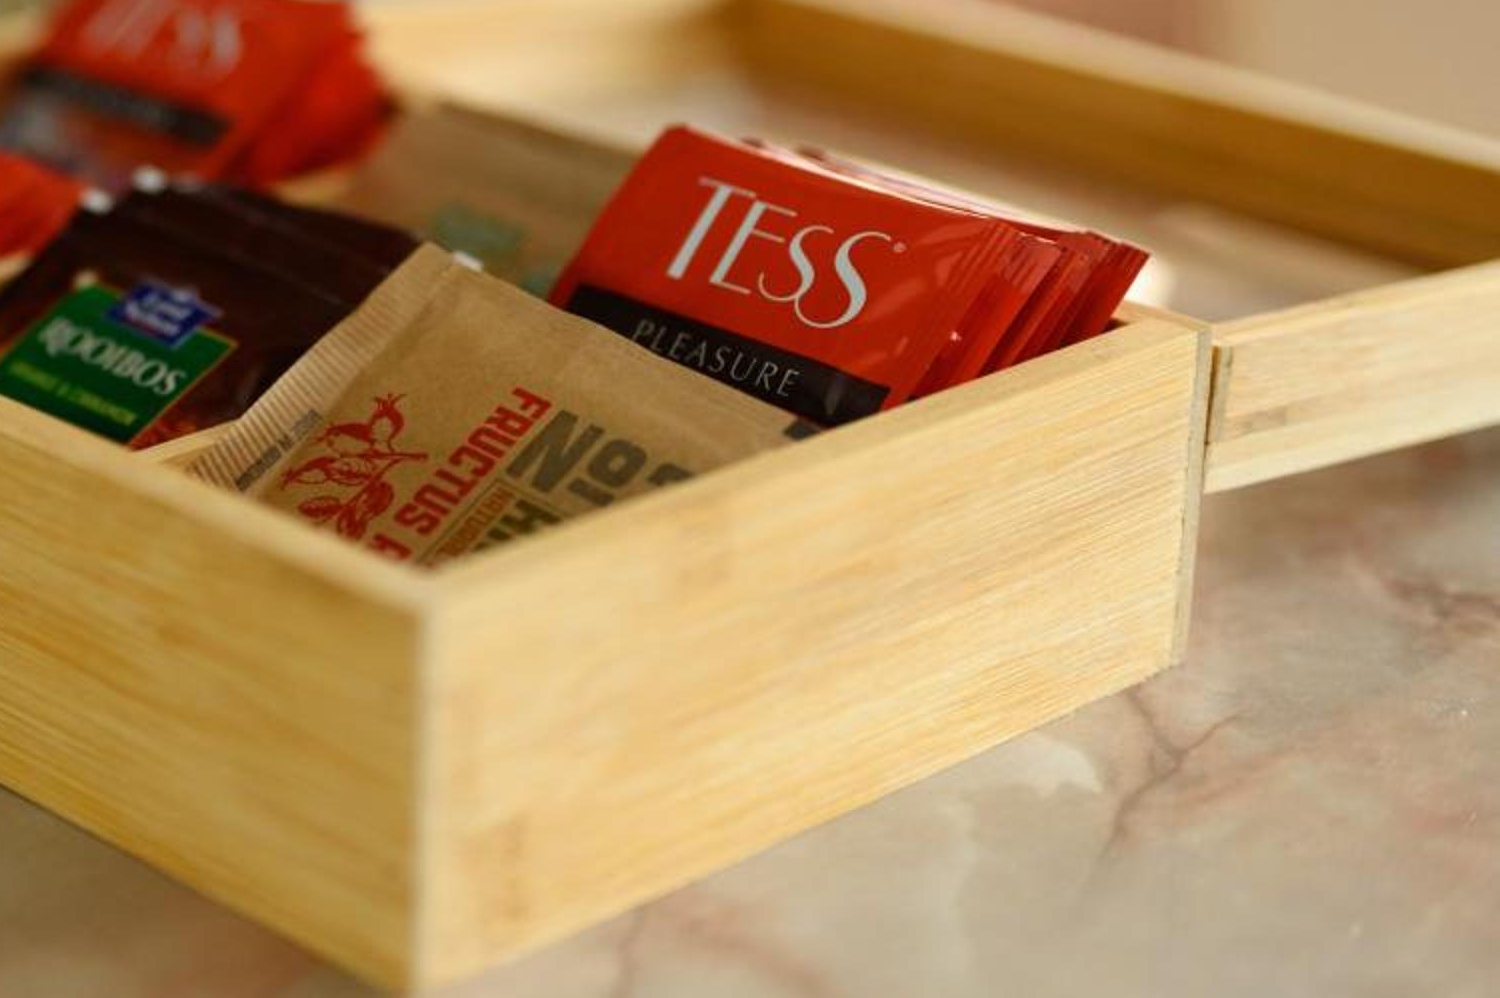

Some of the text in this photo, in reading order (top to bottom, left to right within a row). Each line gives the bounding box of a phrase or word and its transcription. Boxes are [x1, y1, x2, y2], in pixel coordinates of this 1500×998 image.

[666, 176, 892, 329] TESS
[38, 316, 188, 396] ROOIBOS
[631, 318, 800, 398] PLEASURE
[393, 386, 553, 536] FRUCTUS
